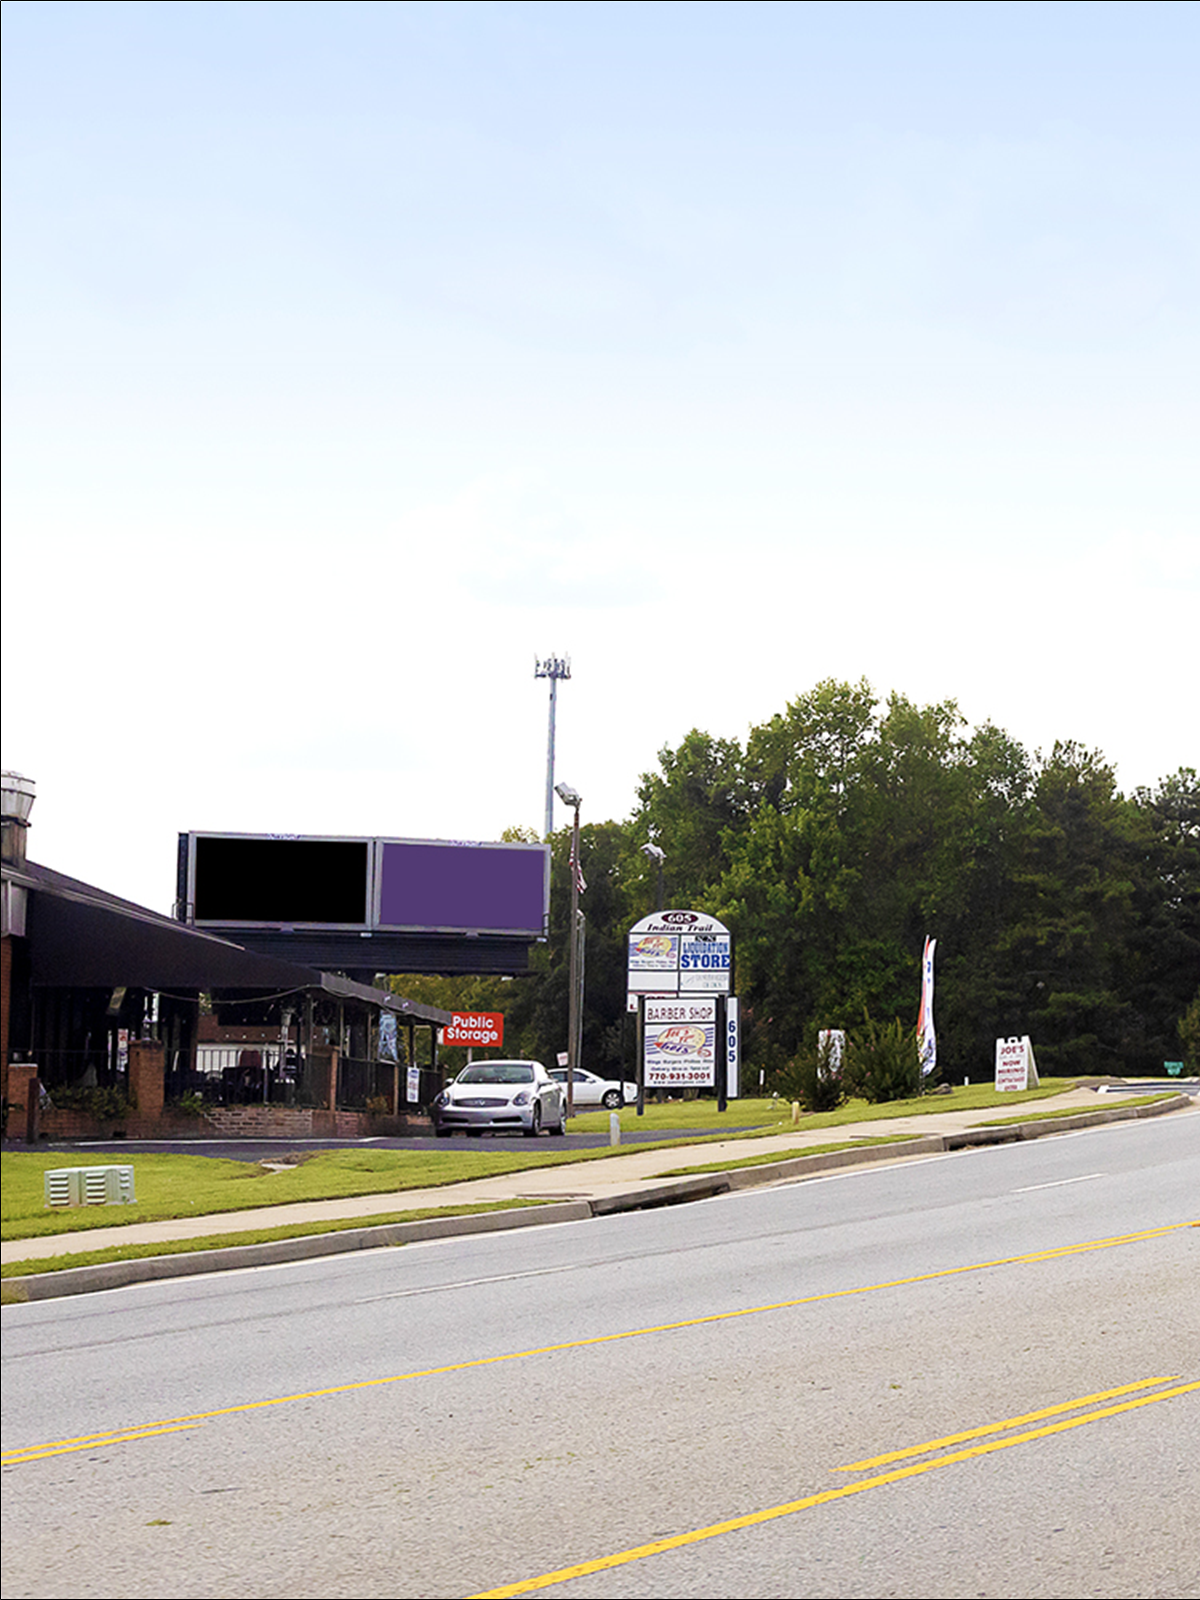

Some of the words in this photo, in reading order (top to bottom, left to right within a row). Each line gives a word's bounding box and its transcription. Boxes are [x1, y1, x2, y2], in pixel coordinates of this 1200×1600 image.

[668, 912, 692, 923] 605
[647, 923, 683, 932] Indian
[687, 923, 713, 932] Trail
[682, 942, 729, 954] LIQUIDATION
[681, 954, 730, 968] STORE
[647, 1007, 686, 1020] BARBER
[689, 1006, 714, 1020] SHOP
[452, 1015, 494, 1028] Public
[447, 1027, 498, 1044] Storage
[728, 1020, 736, 1063] 605
[1001, 1044, 1024, 1055] JOE'S
